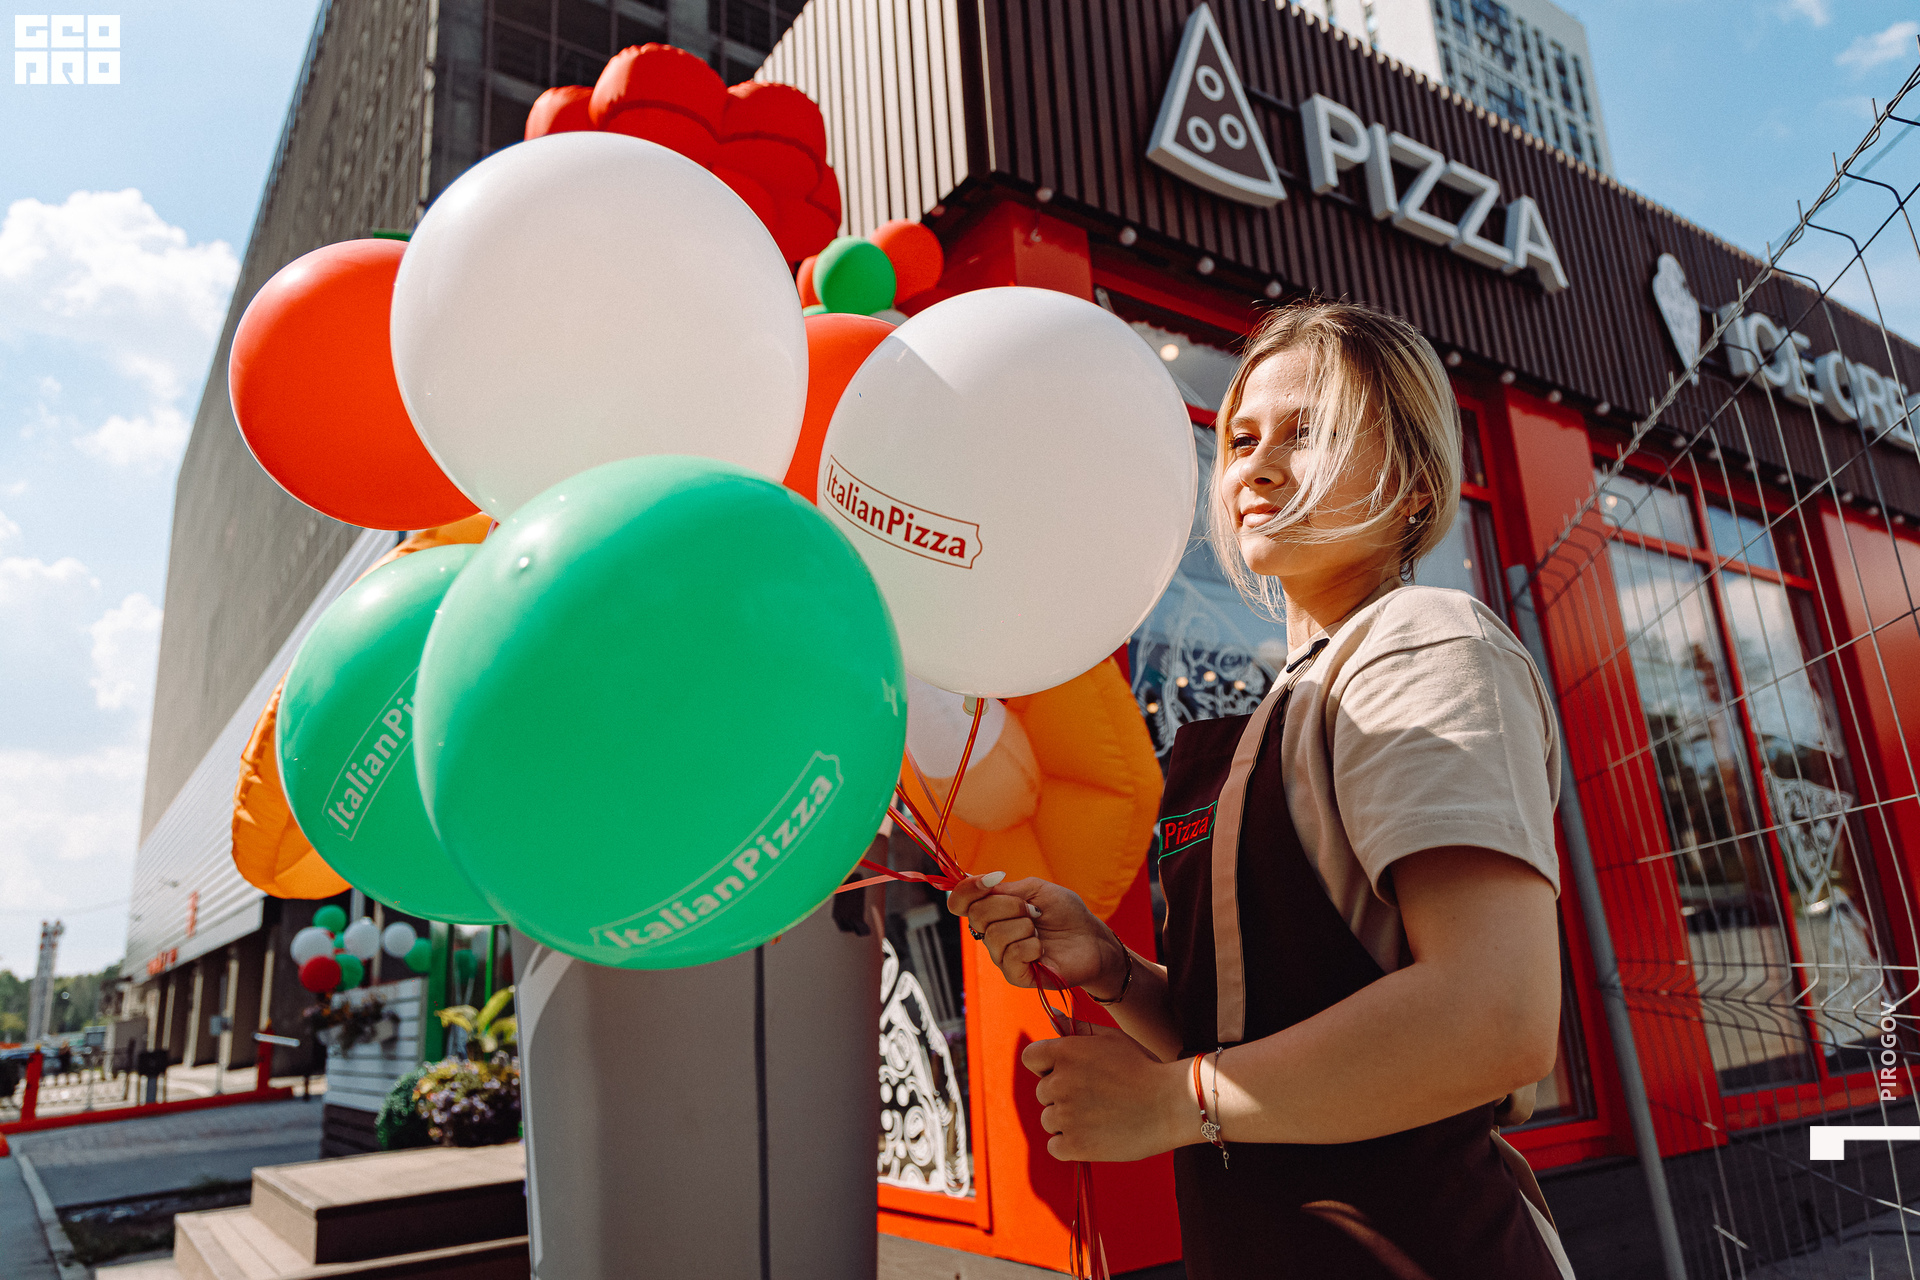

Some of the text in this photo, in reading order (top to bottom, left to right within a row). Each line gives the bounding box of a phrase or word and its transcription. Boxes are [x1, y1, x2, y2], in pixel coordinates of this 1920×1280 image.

[1301, 93, 1569, 293] PIZZA
[1720, 301, 1824, 408] ICE
[827, 464, 967, 559] ItalianPizza
[328, 695, 415, 830] ItalianPi
[604, 775, 833, 949] ItalianPizza
